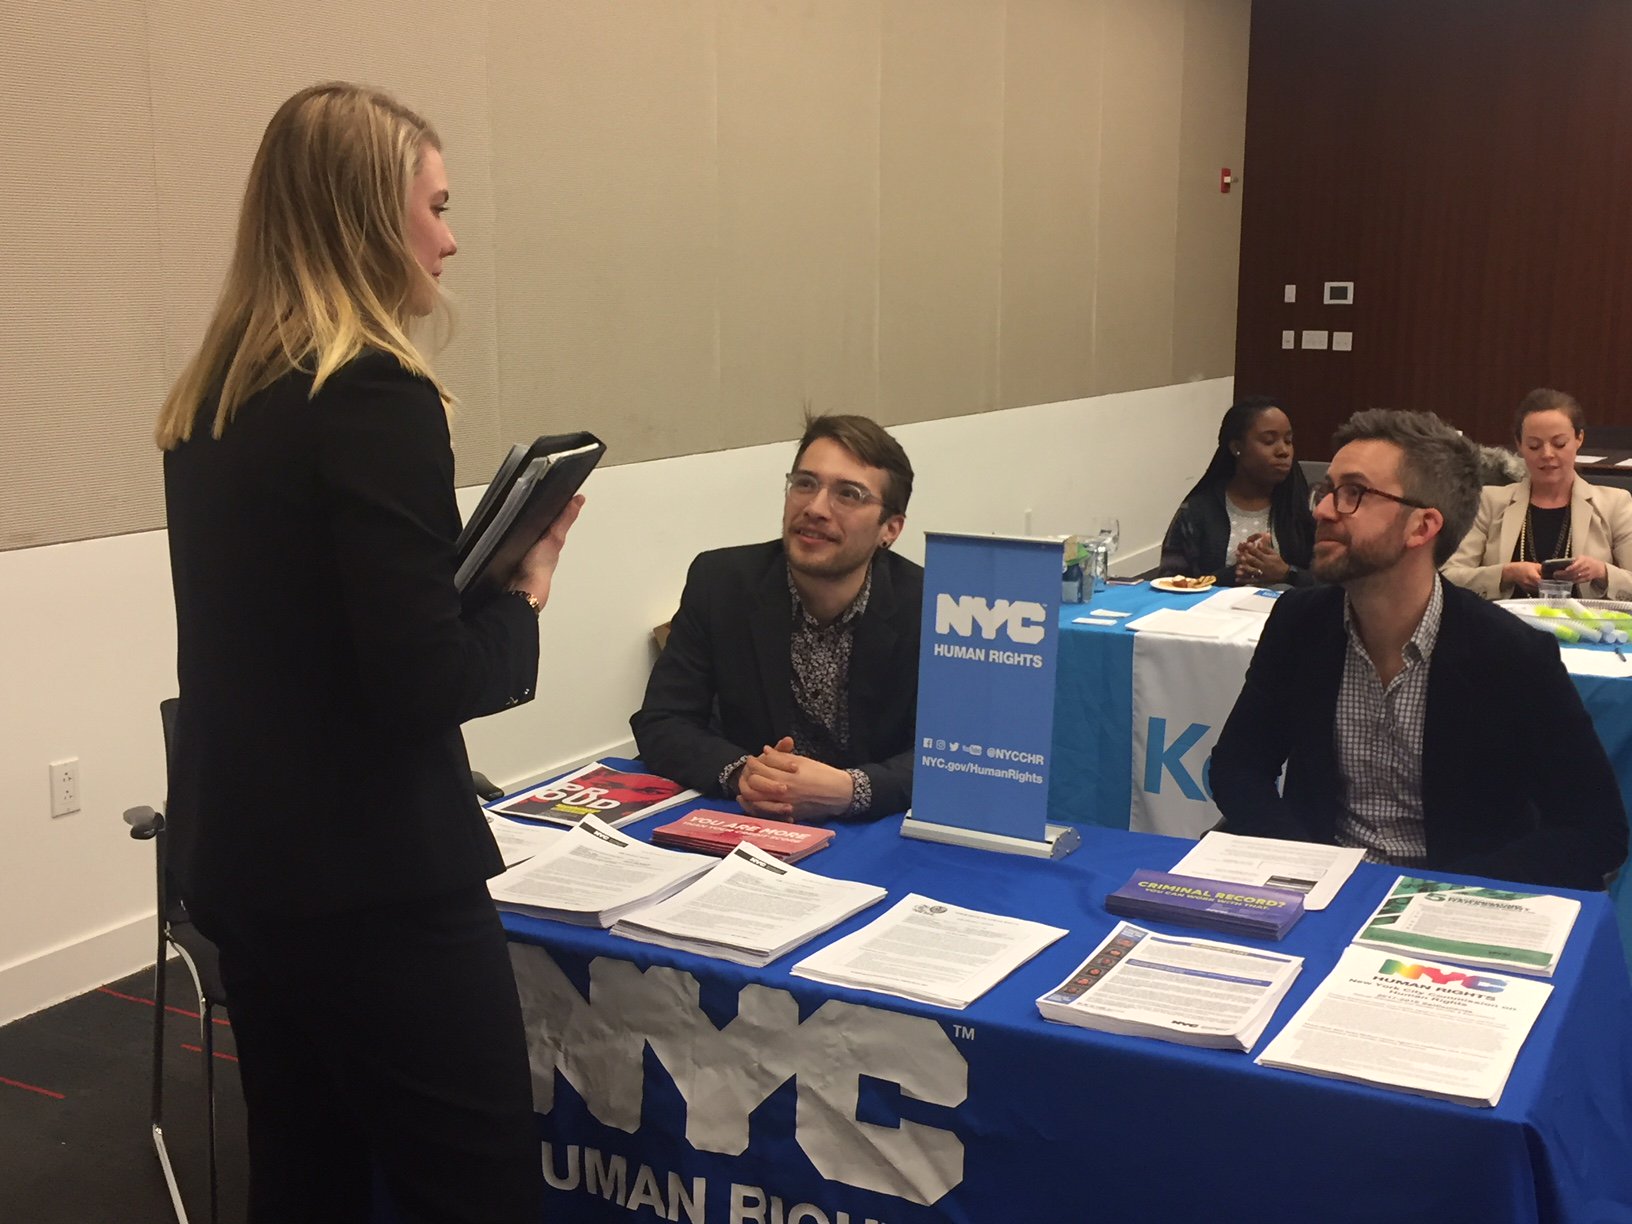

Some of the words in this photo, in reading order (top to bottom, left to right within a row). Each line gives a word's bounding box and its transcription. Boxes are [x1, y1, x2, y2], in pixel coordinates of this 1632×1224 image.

[935, 593, 1046, 645] NYC
[933, 643, 985, 662] HUMAN
[988, 649, 1043, 669] RIGHTS
[986, 747, 1045, 766] @NYCCHR
[1143, 716, 1213, 803] K
[921, 755, 1044, 785] NYC.gov/HumanRights
[593, 830, 610, 841] NYC
[690, 816, 726, 827] YOU
[722, 822, 762, 834] ARE
[758, 828, 812, 841] MORE
[750, 857, 767, 868] NYC
[1137, 881, 1211, 898] CRIMINAL
[1214, 891, 1287, 909] RECORD?
[1144, 888, 1164, 896] YOU
[1164, 890, 1185, 898] CAN
[1186, 894, 1215, 903] WORK
[1216, 898, 1242, 907] WITH
[1372, 976, 1431, 990] HUMAN
[1436, 987, 1496, 1002] RIGHTS
[1379, 959, 1508, 994] NYC
[1348, 978, 1372, 986] New
[1375, 982, 1400, 991] York
[1403, 987, 1425, 996] City
[1428, 992, 1499, 1009] Commission
[1388, 989, 1428, 1000] Human
[1431, 997, 1468, 1008] Rights
[1171, 1020, 1199, 1028] NYC
[507, 942, 969, 1206] NYC
[953, 1024, 976, 1041] TM
[541, 1141, 706, 1224] UMAN
